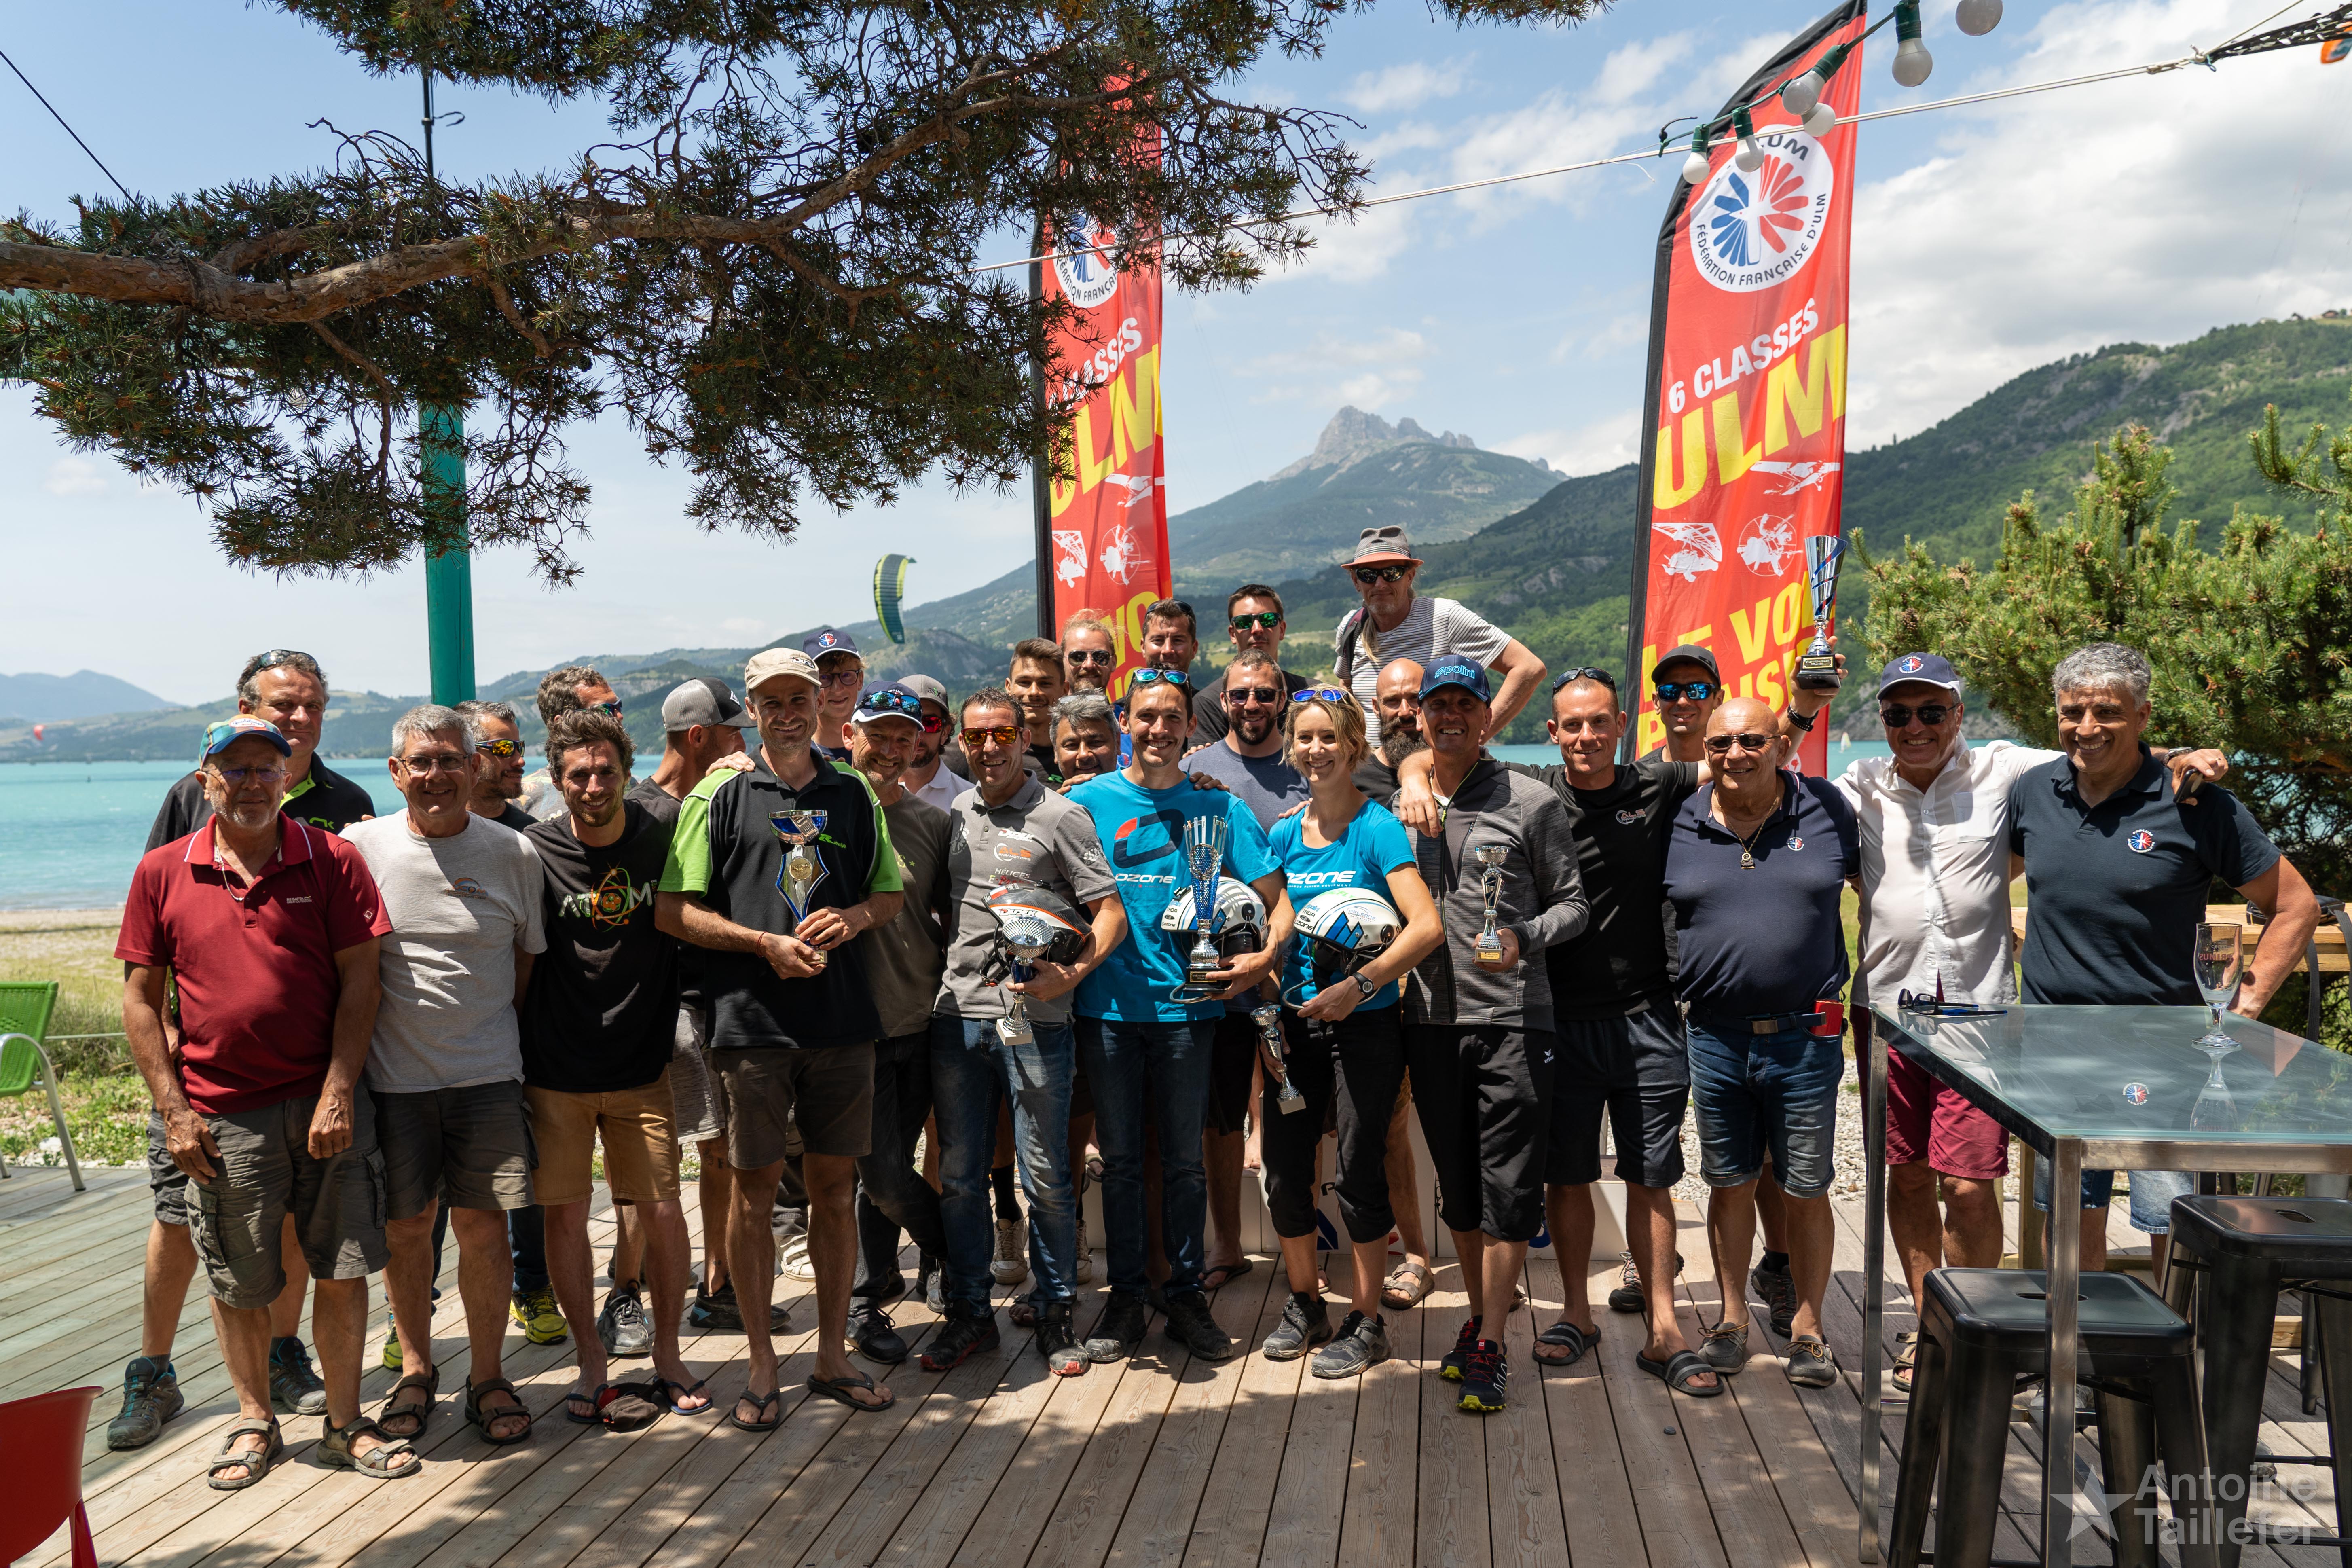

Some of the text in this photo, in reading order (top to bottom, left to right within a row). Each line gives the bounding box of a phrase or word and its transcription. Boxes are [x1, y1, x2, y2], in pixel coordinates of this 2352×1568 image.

[1697, 193, 1827, 285] FÉDÉRATION FRANÇAISE D'ULM
[1669, 298, 1819, 414] 6 CLASSES
[1653, 322, 1847, 510] ULM
[1444, 665, 1475, 679] polini
[1621, 809, 1646, 819] ALS
[998, 853, 1031, 861] PARAMOTORS
[999, 846, 1031, 858] ALS
[995, 868, 1031, 879] HÉLICES
[1115, 873, 1175, 884] OZONE
[1302, 909, 1316, 918] THOR
